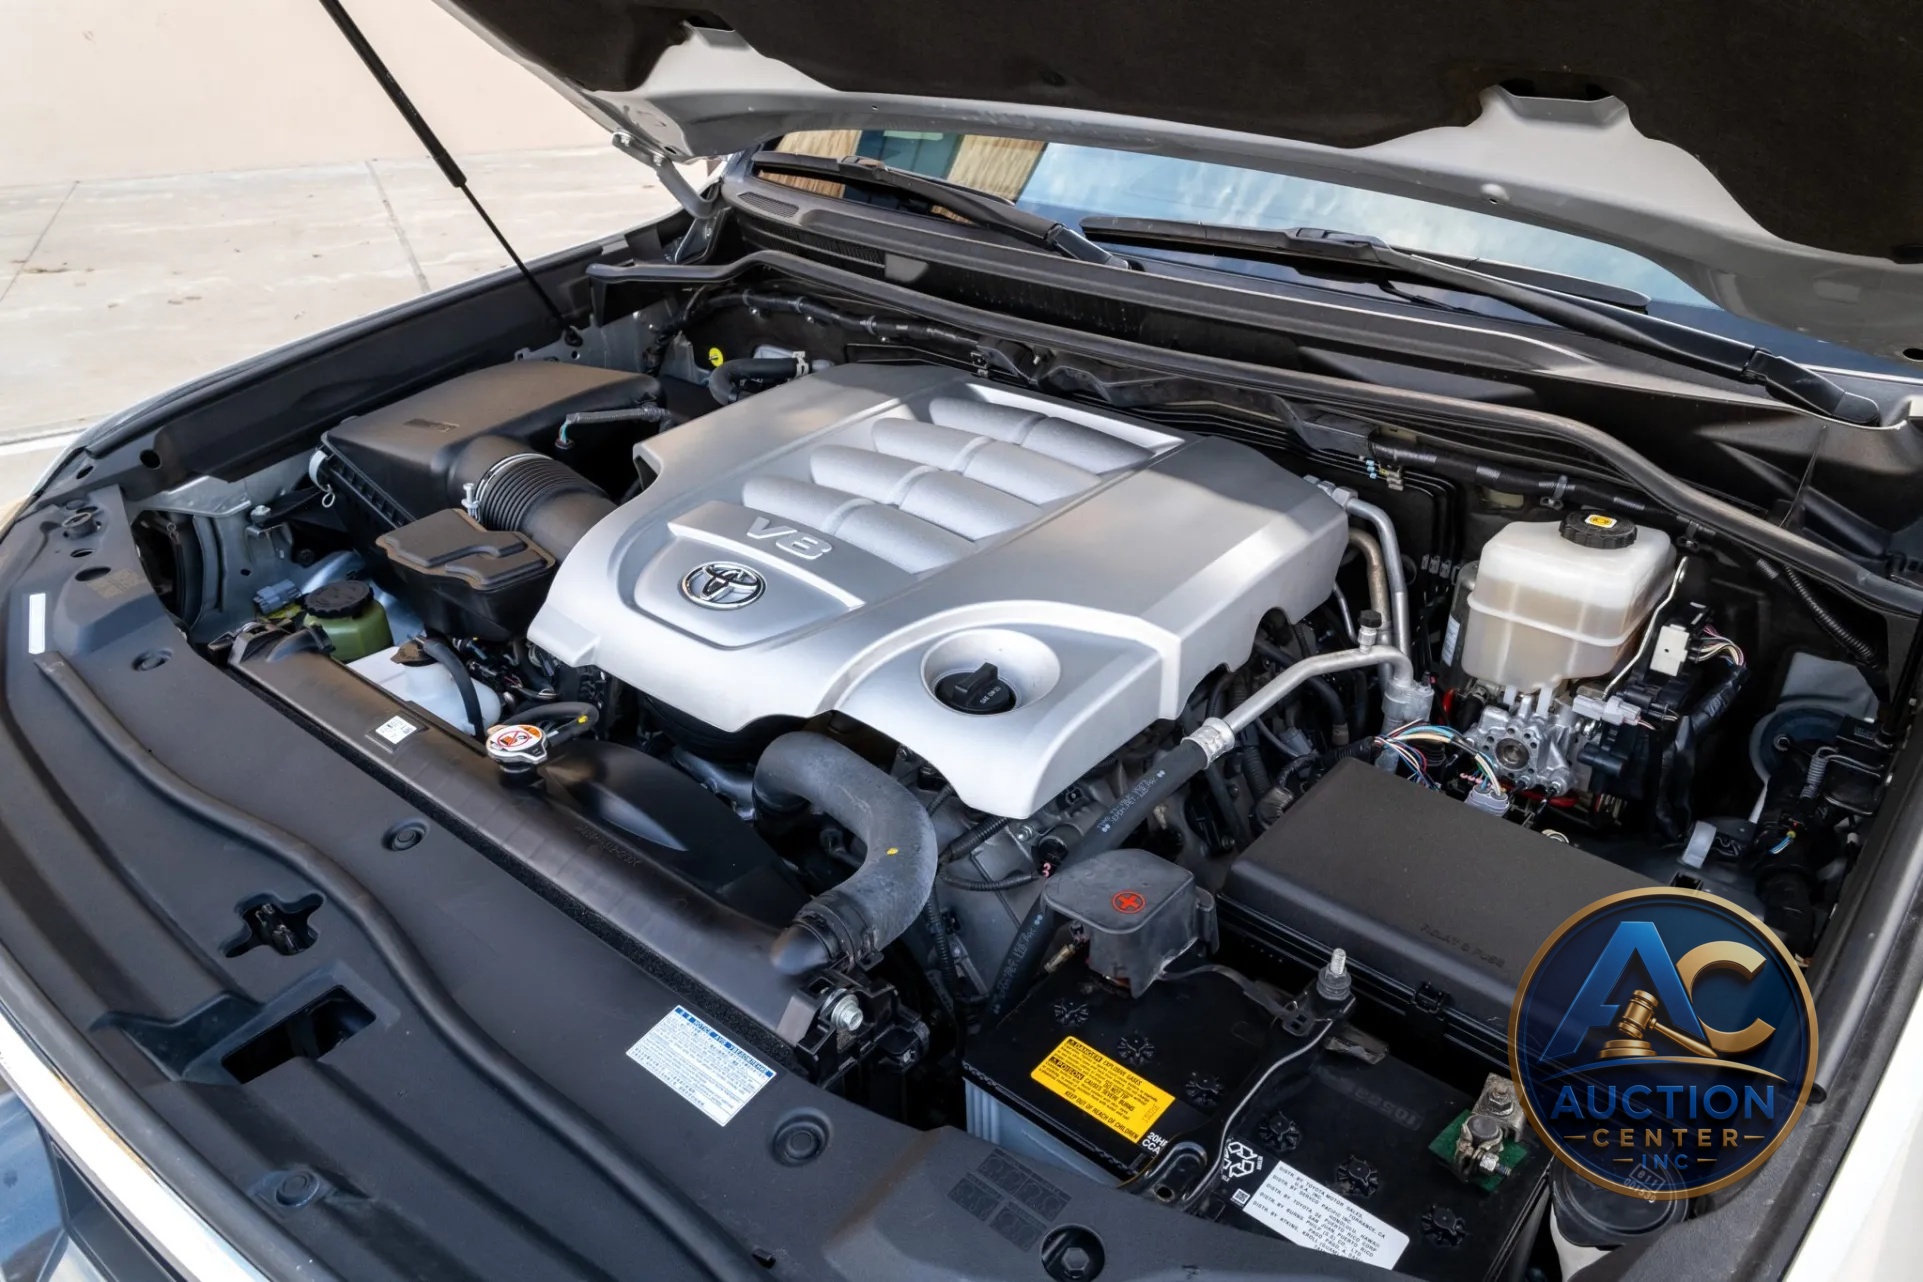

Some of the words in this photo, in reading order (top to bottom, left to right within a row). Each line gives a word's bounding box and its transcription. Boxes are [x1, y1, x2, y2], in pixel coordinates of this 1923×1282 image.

[747, 516, 832, 560] V8
[1057, 1061, 1083, 1079] POISON
[1084, 1078, 1102, 1091] CAUSES
[1102, 1089, 1119, 1101] SEVERE
[1118, 1099, 1135, 1111] BURNS
[1064, 1091, 1077, 1100] KEEP
[1076, 1098, 1086, 1106] OUT
[1092, 1108, 1108, 1120] REACH
[1114, 1122, 1139, 1139] CHILDREN
[1306, 1182, 1325, 1195] TOYOTA
[1326, 1194, 1344, 1206] MOTOR
[1286, 1208, 1304, 1220] BURNS
[1306, 1220, 1321, 1231] PHILP
[1293, 1200, 1313, 1213] TOYOTA
[1324, 1219, 1345, 1232] PUERTO
[1347, 1232, 1360, 1242] RICO
[1302, 1231, 1318, 1242] KROLL
[1308, 1228, 1323, 1239] PAGO
[1337, 1233, 1358, 1247] PUERTO
[1360, 1247, 1374, 1257] RICO
